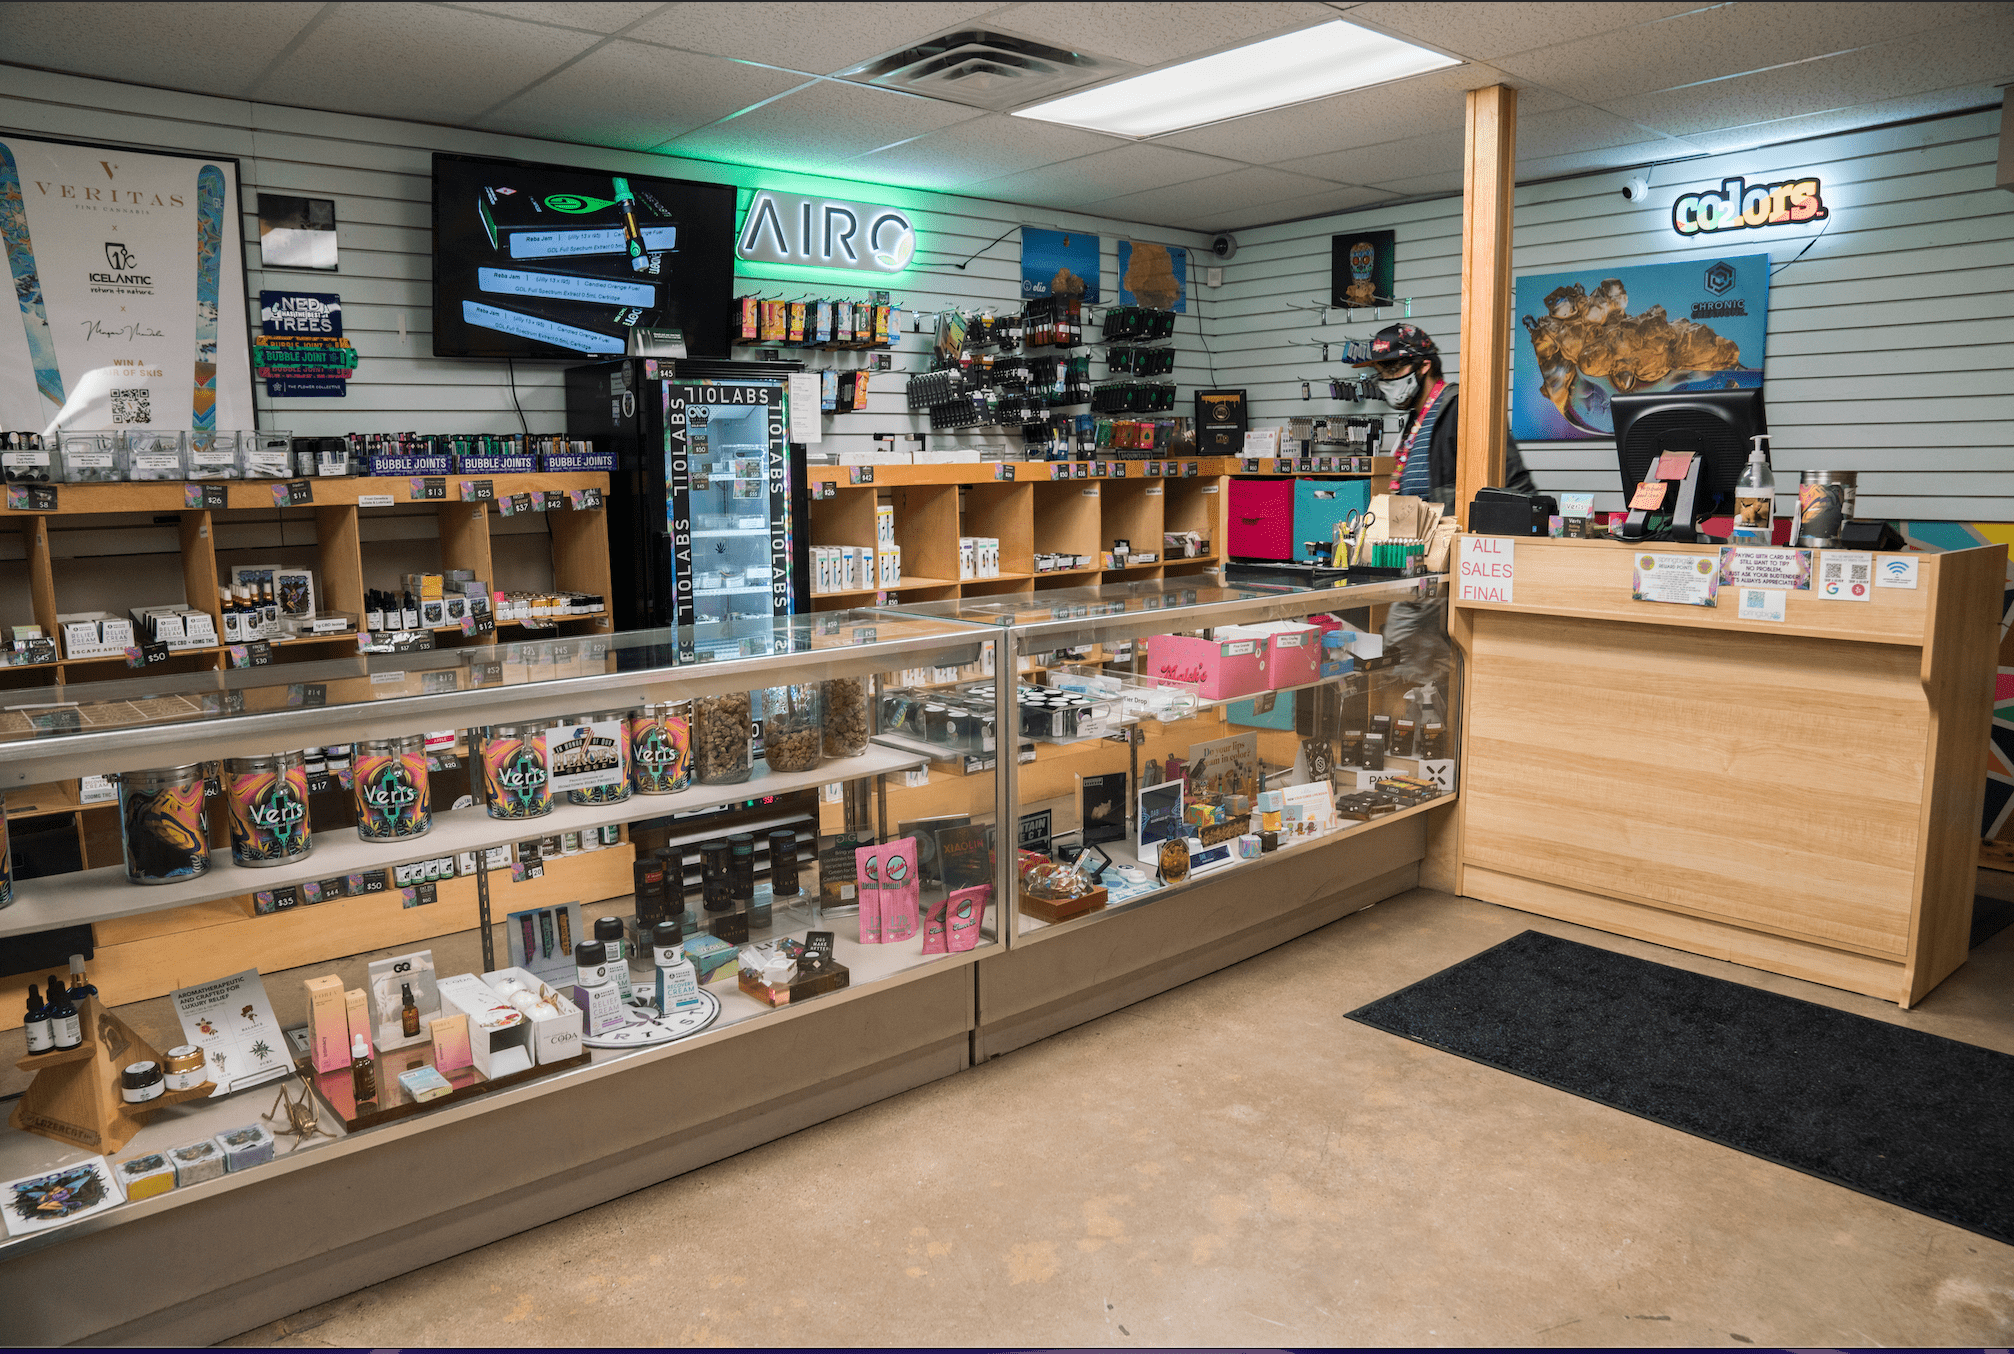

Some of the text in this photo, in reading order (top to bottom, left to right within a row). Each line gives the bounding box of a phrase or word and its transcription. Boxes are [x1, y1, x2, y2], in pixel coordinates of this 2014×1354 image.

[34, 181, 184, 208] VERITAS
[102, 206, 150, 215] CANNABIS
[743, 198, 912, 267] AIRO
[89, 273, 152, 285] ICELANTIC
[538, 287, 562, 296] Spectrum
[604, 282, 627, 291] Orange
[281, 297, 320, 312] NED
[1691, 299, 1746, 312] CHRONIC
[270, 317, 333, 333] TREES
[575, 329, 597, 341] Orange
[266, 352, 327, 362] BUBBLE JOINT
[113, 359, 134, 367] WIN
[123, 369, 163, 377] OF SKIS
[660, 369, 674, 378] $45
[375, 457, 447, 470] BUBBLE JOINTS
[465, 457, 532, 469] BUBBLE JOINTS
[549, 456, 613, 467] BUBBLE JOINTS
[293, 491, 307, 499] $14
[427, 488, 443, 496] $13
[477, 490, 491, 498] $25
[39, 501, 49, 509] $8
[207, 496, 223, 505] $26
[547, 500, 561, 508] $42
[515, 503, 529, 512] $37
[1472, 538, 1502, 554] ALL
[1461, 561, 1513, 578] SALES
[1463, 585, 1508, 602] FINAL
[478, 621, 493, 630] $12
[148, 652, 166, 662] $50
[255, 657, 268, 665] $30
[1132, 697, 1148, 705] Drop
[1203, 741, 1245, 758] Do your lips
[553, 745, 618, 772] HEROES
[311, 781, 328, 792] $17
[943, 839, 984, 854] XIAOLIN
[366, 881, 382, 891] $50
[326, 888, 340, 897] $44
[277, 897, 294, 907] $35
[393, 961, 411, 973] GQ
[177, 976, 245, 999] AROMATHERAPEUTIC
[666, 981, 694, 989] RECOVERY
[180, 984, 240, 1005] AND CRAFTED FOR
[667, 986, 695, 996] CREAM
[181, 1000, 207, 1010] LUXURY
[208, 994, 230, 1003] RELIEF
[592, 997, 618, 1009] RELIEF
[593, 1003, 620, 1016] CREAM
[550, 1031, 578, 1045] CODA
